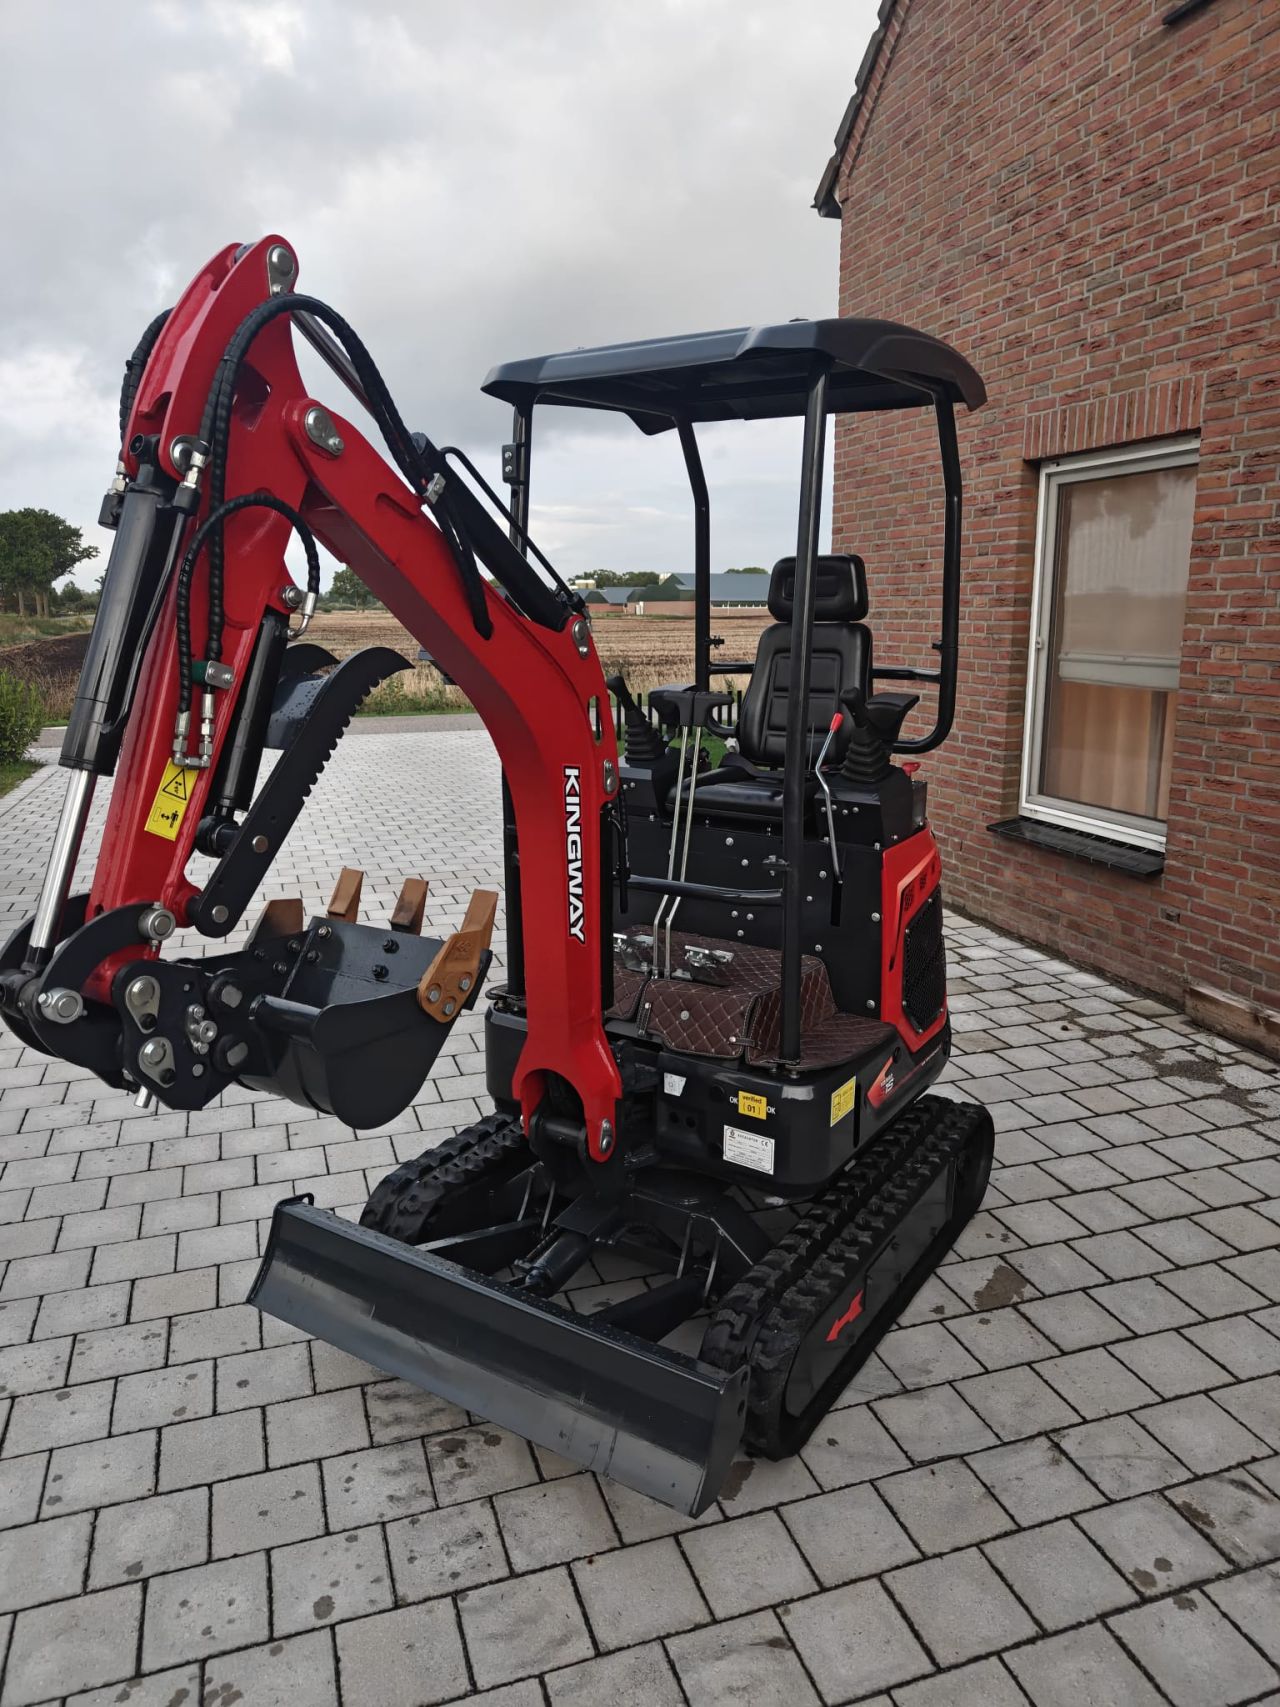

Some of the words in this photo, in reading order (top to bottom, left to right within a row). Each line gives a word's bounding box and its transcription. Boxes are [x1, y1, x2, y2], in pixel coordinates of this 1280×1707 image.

[564, 767, 585, 942] KINGWAY
[729, 1096, 738, 1105] OK
[767, 1105, 776, 1115] OK
